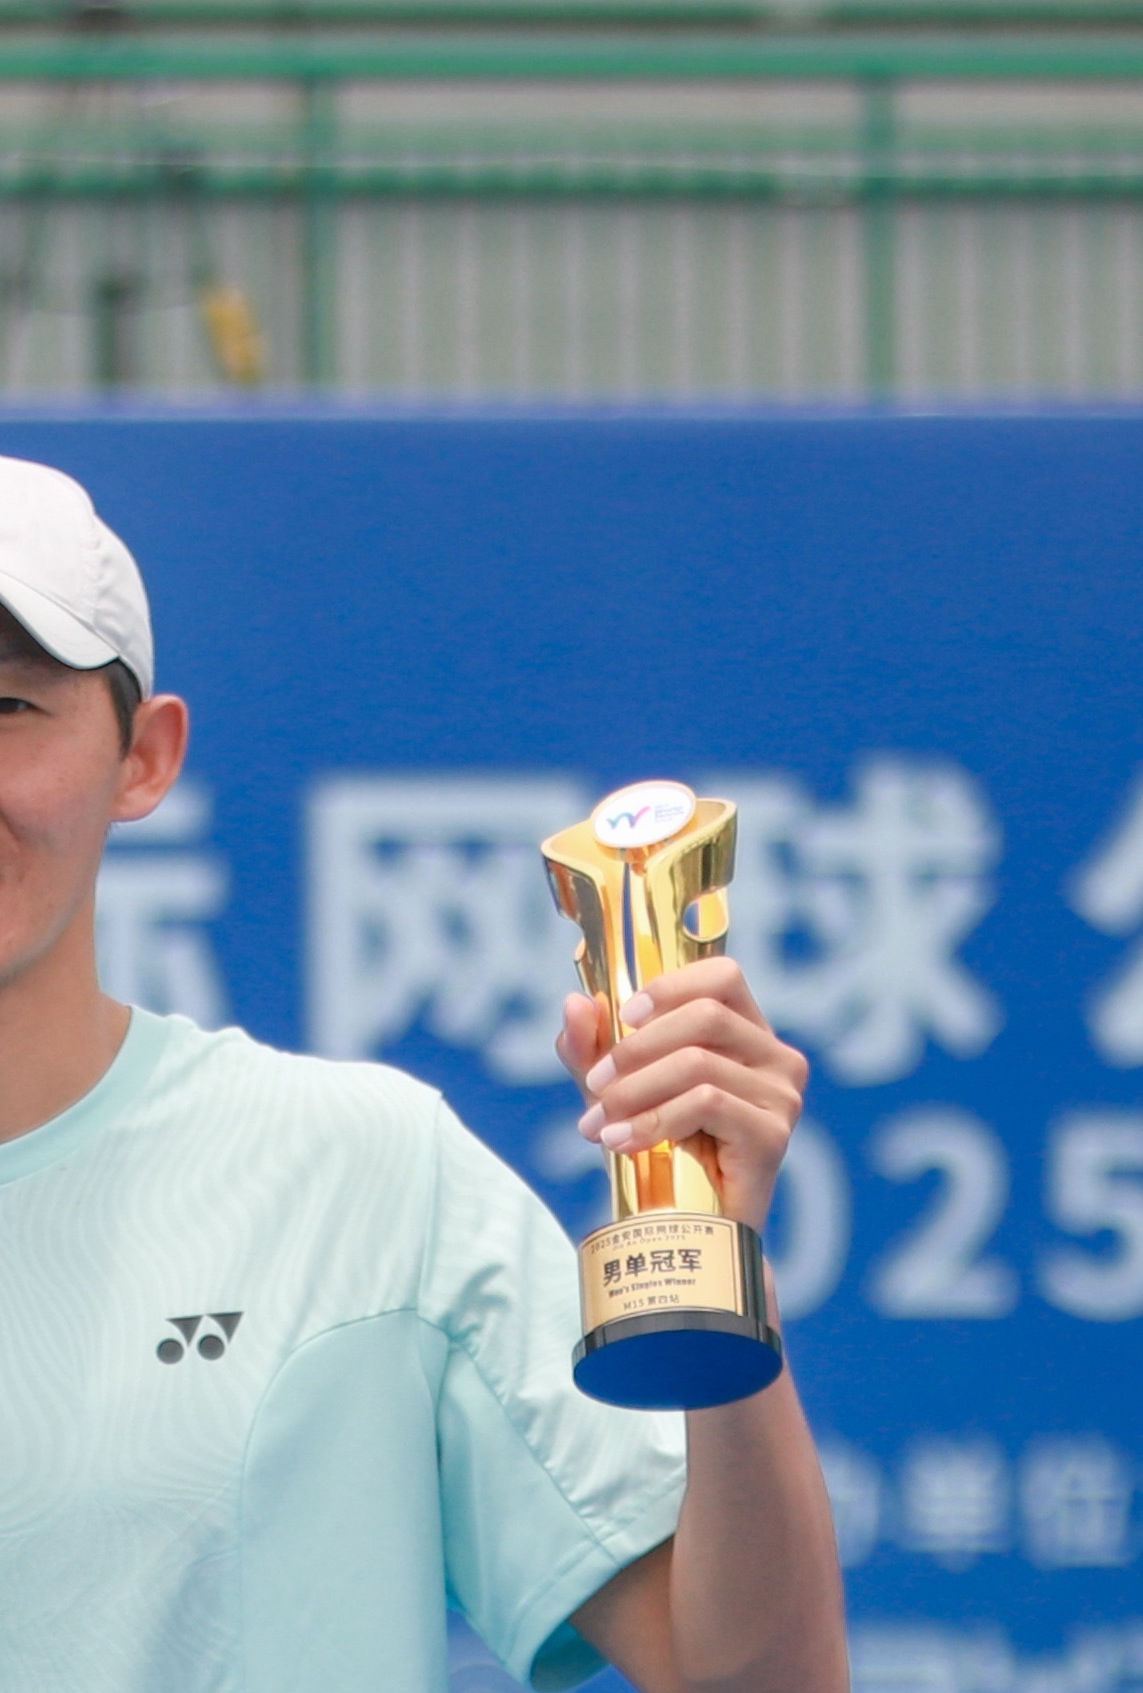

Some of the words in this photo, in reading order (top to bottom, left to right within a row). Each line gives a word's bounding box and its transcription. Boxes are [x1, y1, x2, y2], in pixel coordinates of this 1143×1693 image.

[540, 1112, 1143, 1320] 25
[602, 1248, 702, 1288] 男单冠军
[631, 1279, 662, 1292] Singles
[664, 1277, 696, 1286] Winner
[623, 1299, 644, 1311] M15
[647, 1295, 679, 1306] 第四站
